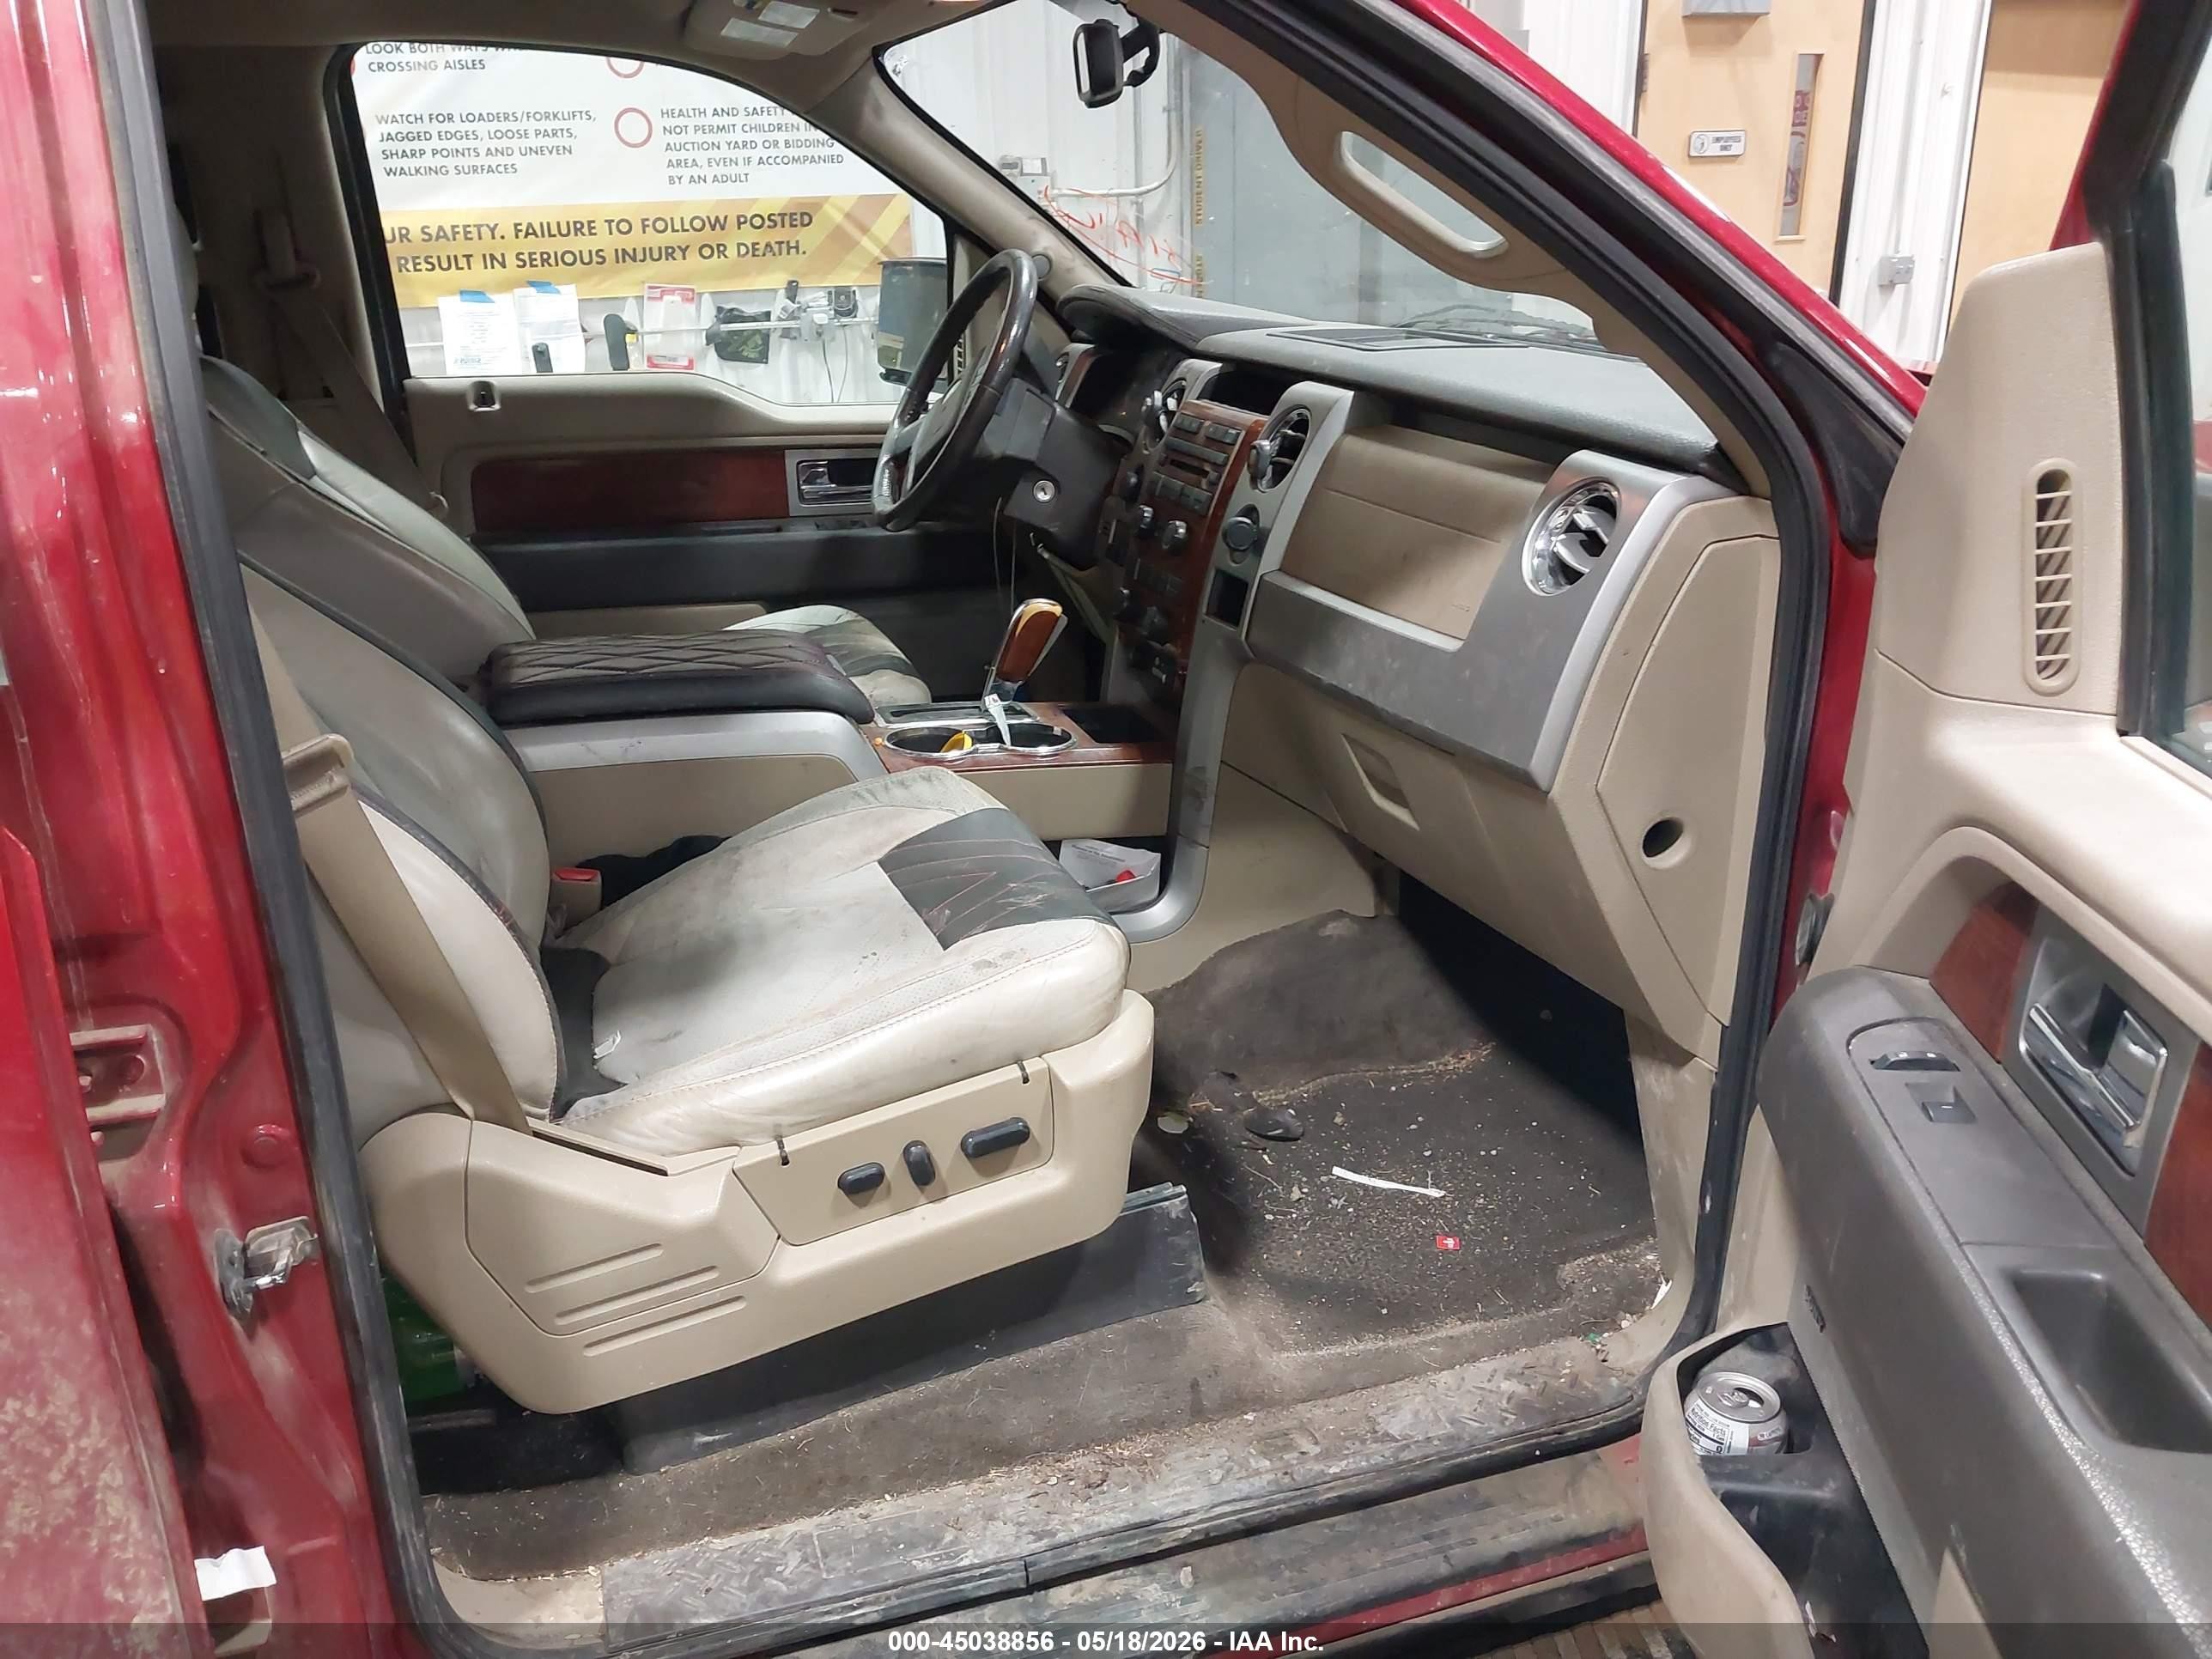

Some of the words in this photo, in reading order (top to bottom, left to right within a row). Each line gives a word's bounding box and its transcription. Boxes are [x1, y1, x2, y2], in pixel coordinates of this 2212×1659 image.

[366, 44, 404, 54] LOOK
[410, 44, 445, 53] BOTH
[368, 61, 438, 72] CROSSING
[444, 59, 485, 70] AISLES
[375, 114, 423, 125] WATCH
[428, 113, 455, 124] FOR
[459, 110, 597, 124] LOADERS/FORKLIFTS,
[661, 107, 707, 118] HEALTH
[712, 107, 739, 118] AND
[744, 106, 785, 117] SAFETY
[379, 131, 432, 143] JAGGED
[437, 130, 483, 143] EDGES,
[488, 129, 530, 140] LOOSE
[534, 128, 577, 140] PARTS,
[663, 125, 689, 136] NOT
[694, 124, 738, 135] PERMIT
[741, 122, 800, 133] CHILDREN
[665, 141, 720, 152] AUCTION
[725, 140, 757, 150] YARD
[763, 139, 780, 149] OR
[784, 137, 835, 149] BIDDING
[381, 149, 426, 160] SHARP
[431, 148, 480, 159] POINTS
[485, 147, 514, 157] AND
[519, 145, 572, 156] UNEVEN
[666, 158, 702, 169] AREA,
[708, 157, 738, 167] EVEN
[743, 156, 753, 166] IF
[757, 154, 844, 166] ACCOMPANIED
[384, 165, 449, 177] WALKING
[454, 163, 518, 176] SURFACES
[668, 175, 684, 185] BY
[689, 174, 707, 184] AN
[712, 173, 750, 184] ADULT
[421, 223, 505, 243] SAFETY.
[514, 220, 597, 240] FAILURE
[604, 218, 633, 235] TO
[641, 215, 728, 234] FOLLOW
[737, 212, 812, 230] POSTED
[398, 253, 474, 272] RESULT
[483, 252, 507, 270] IN
[515, 248, 606, 268] SERIOUS
[614, 245, 690, 264] INJURY
[697, 243, 729, 260] OR
[737, 240, 806, 258] DEATH.
[1710, 1423, 1726, 1436] Facts
